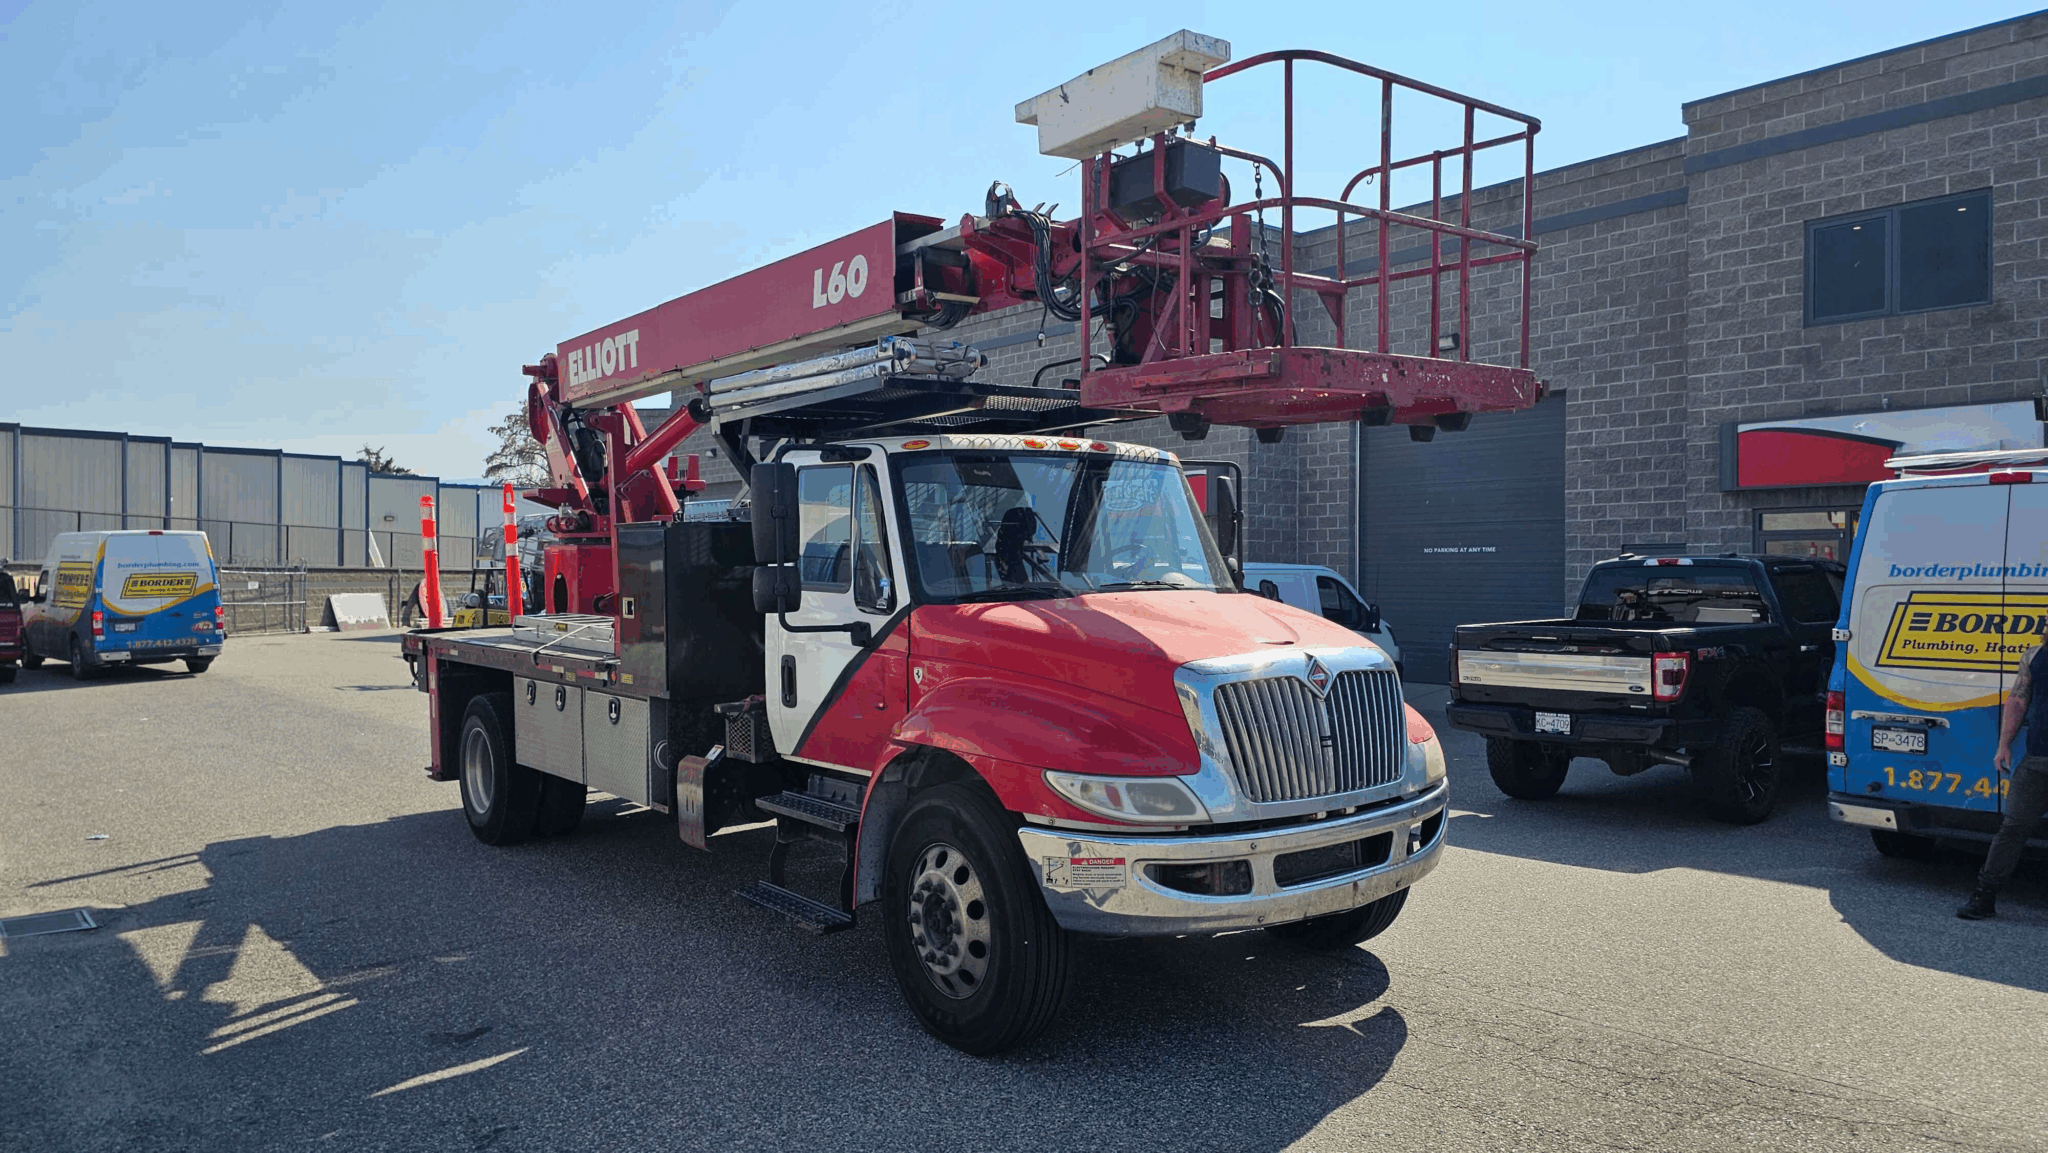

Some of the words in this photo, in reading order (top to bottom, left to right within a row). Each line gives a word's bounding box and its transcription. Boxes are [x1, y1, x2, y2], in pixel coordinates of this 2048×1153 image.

[813, 254, 869, 309] L60
[568, 329, 639, 387] ELLIOTT
[140, 578, 185, 587] BORDER
[1697, 646, 1725, 661] FX4
[1902, 638, 1979, 655] Plumbing,
